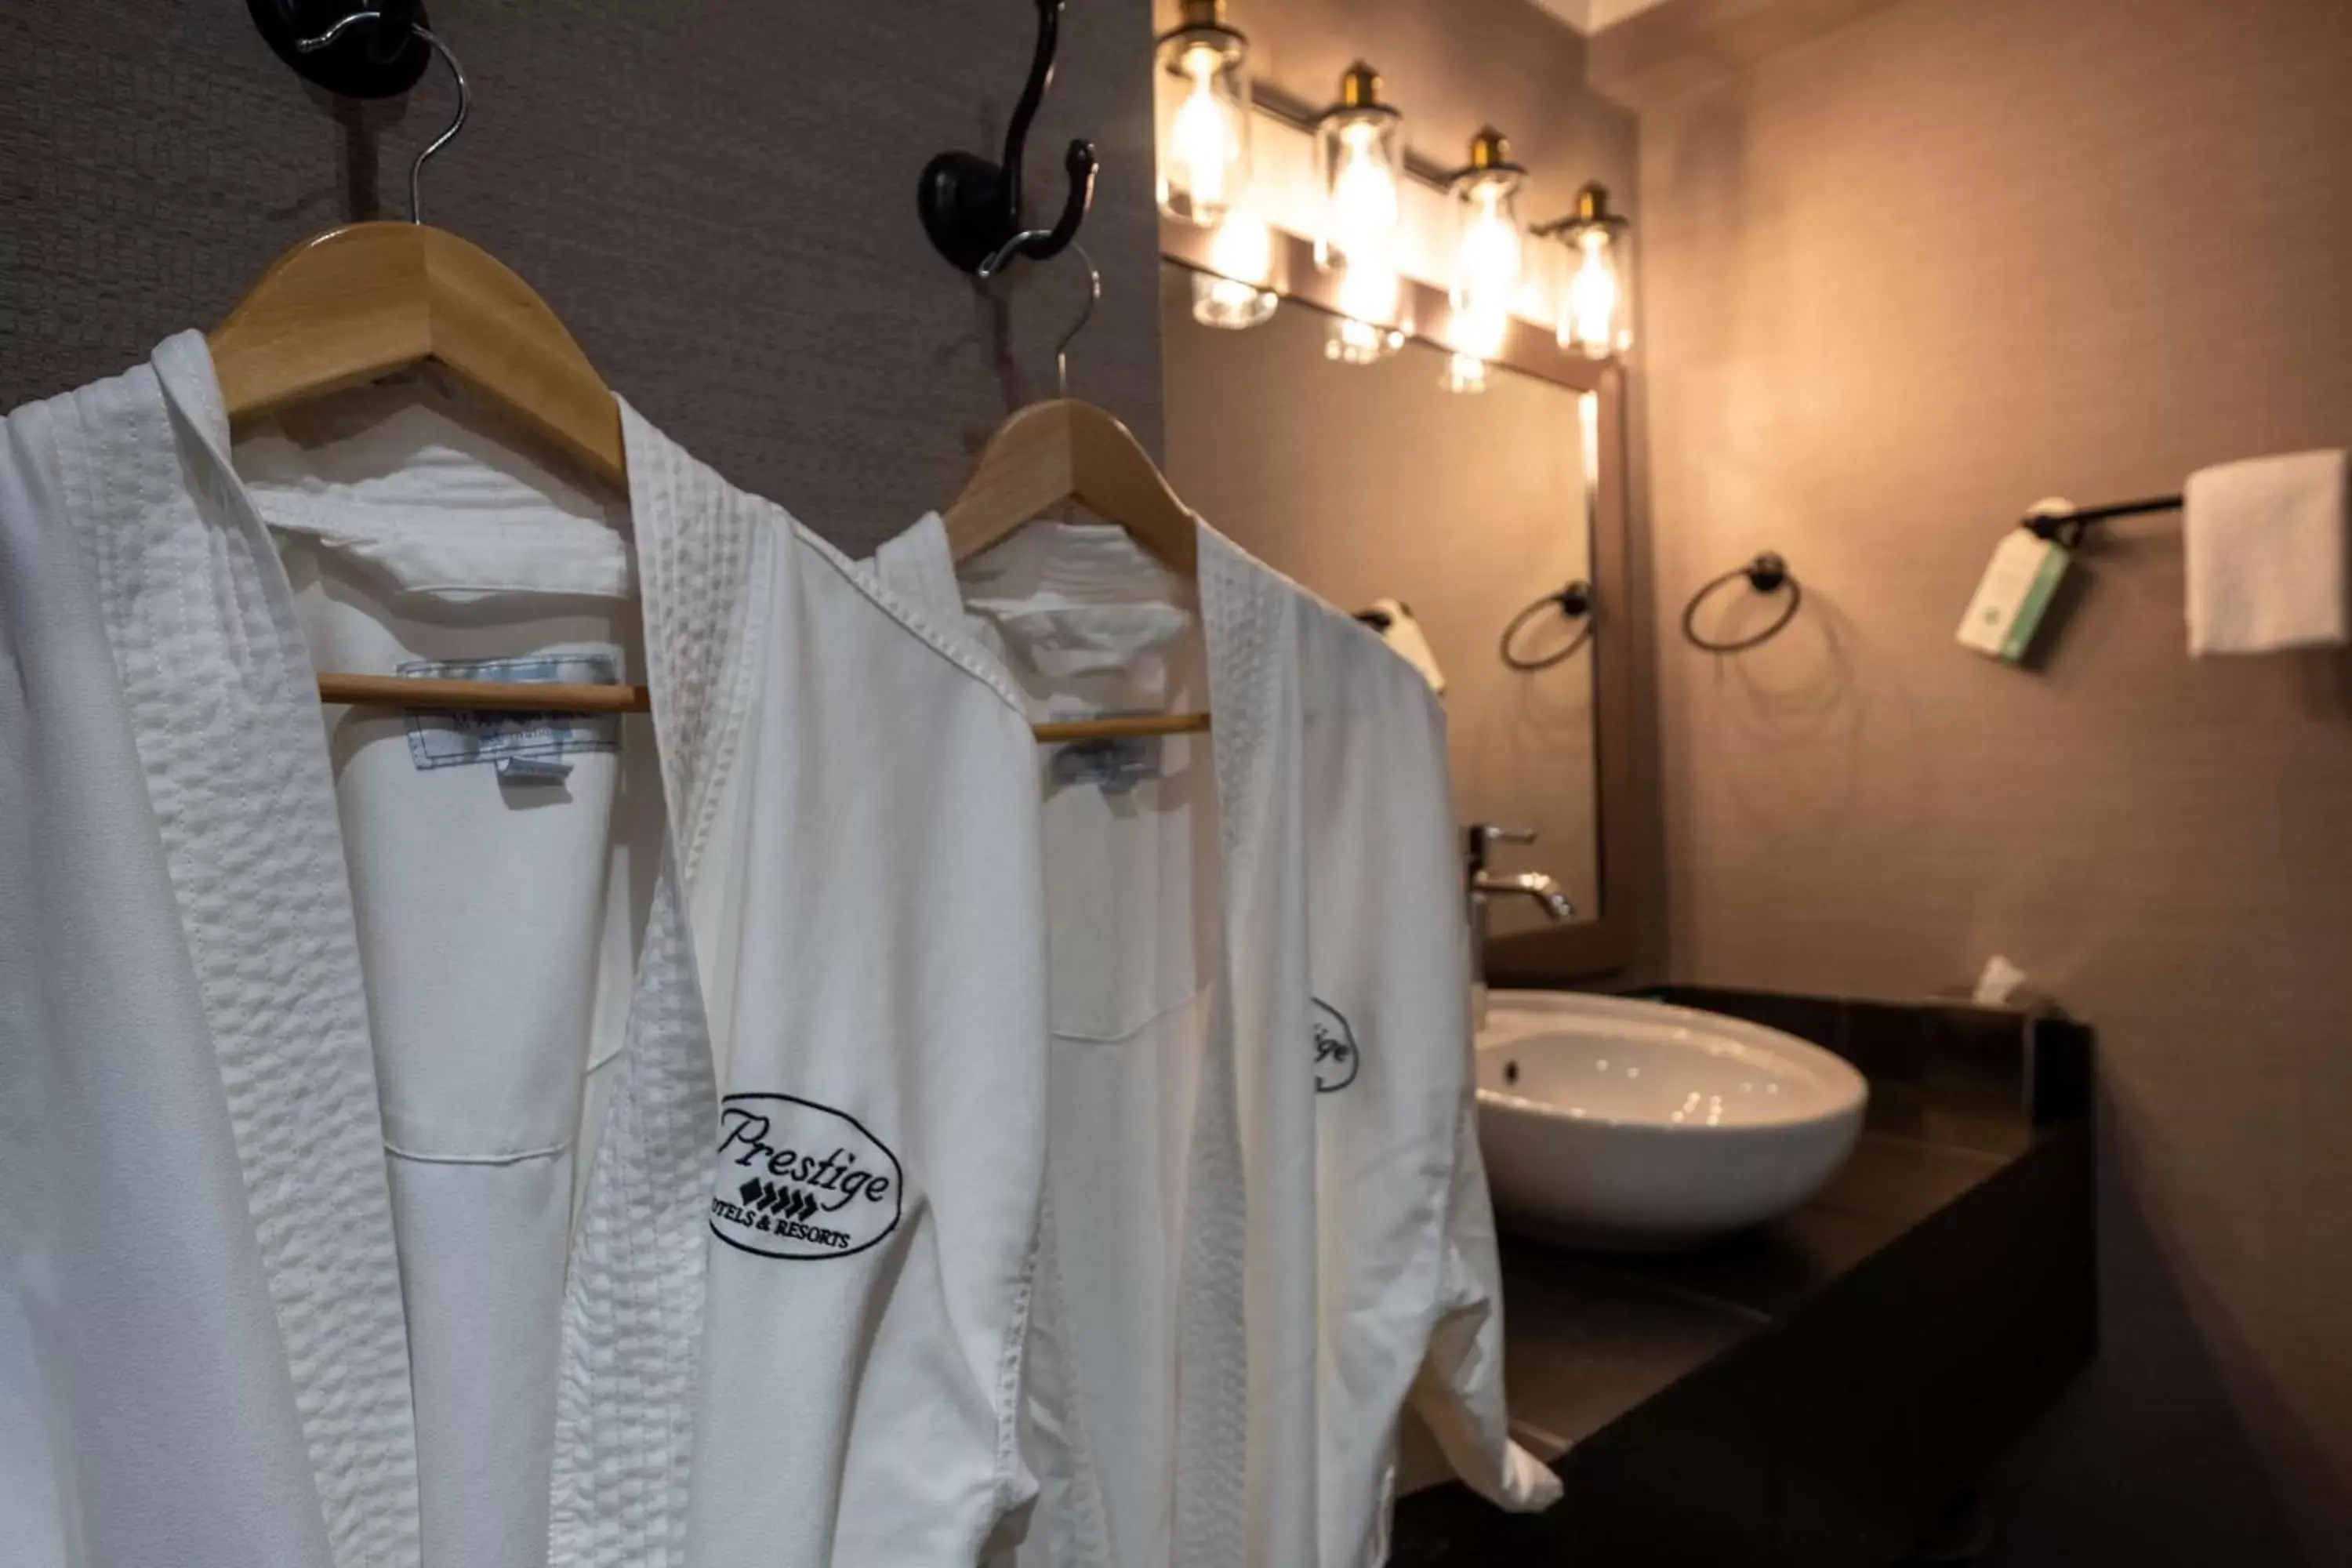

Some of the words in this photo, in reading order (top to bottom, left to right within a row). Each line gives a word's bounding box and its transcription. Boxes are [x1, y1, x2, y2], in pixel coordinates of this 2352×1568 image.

[718, 1108, 890, 1212] Prestige
[756, 1216, 771, 1232] &
[775, 1218, 851, 1249] RESORTS
